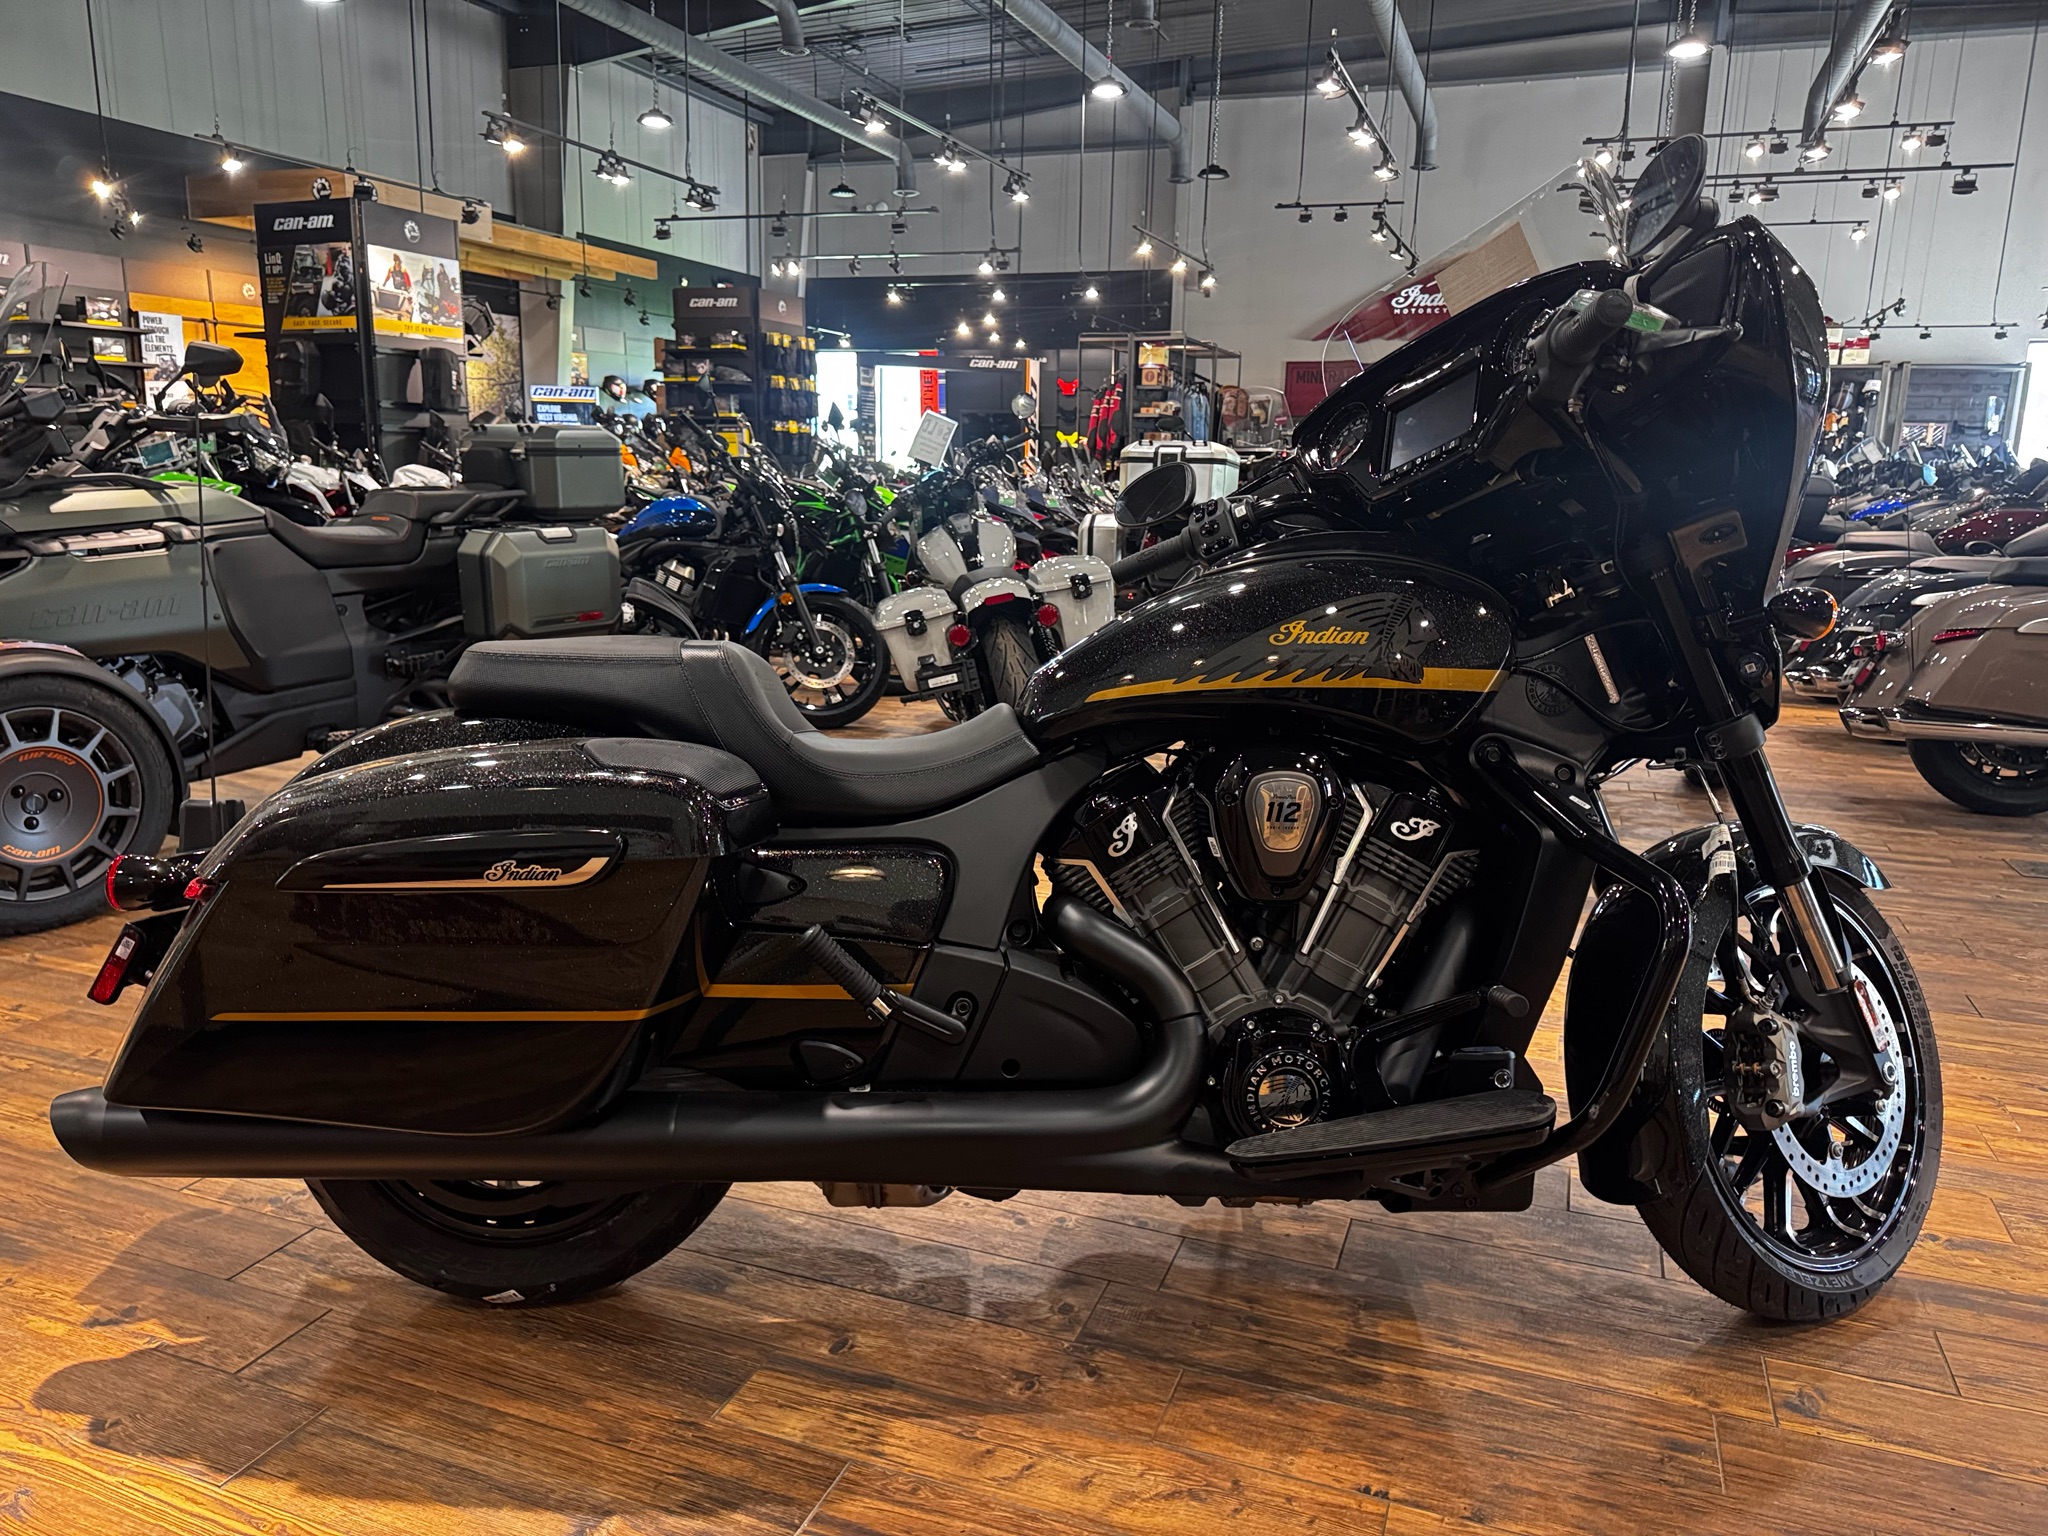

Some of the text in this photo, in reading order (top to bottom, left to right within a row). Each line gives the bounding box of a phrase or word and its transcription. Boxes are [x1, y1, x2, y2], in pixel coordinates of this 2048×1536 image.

[273, 214, 334, 231] can-am
[689, 297, 738, 307] can-am
[142, 315, 163, 325] POWER
[155, 334, 166, 344] THE
[144, 343, 173, 353] ELEMENTS
[969, 358, 1018, 369] can-am
[533, 387, 595, 398] can-am
[1269, 620, 1370, 646] Indian
[1265, 801, 1302, 823] 112
[2, 844, 60, 859] can-am
[484, 860, 562, 882] Indian
[1789, 1040, 1800, 1097] brembo
[1246, 1064, 1268, 1122] INDIAN
